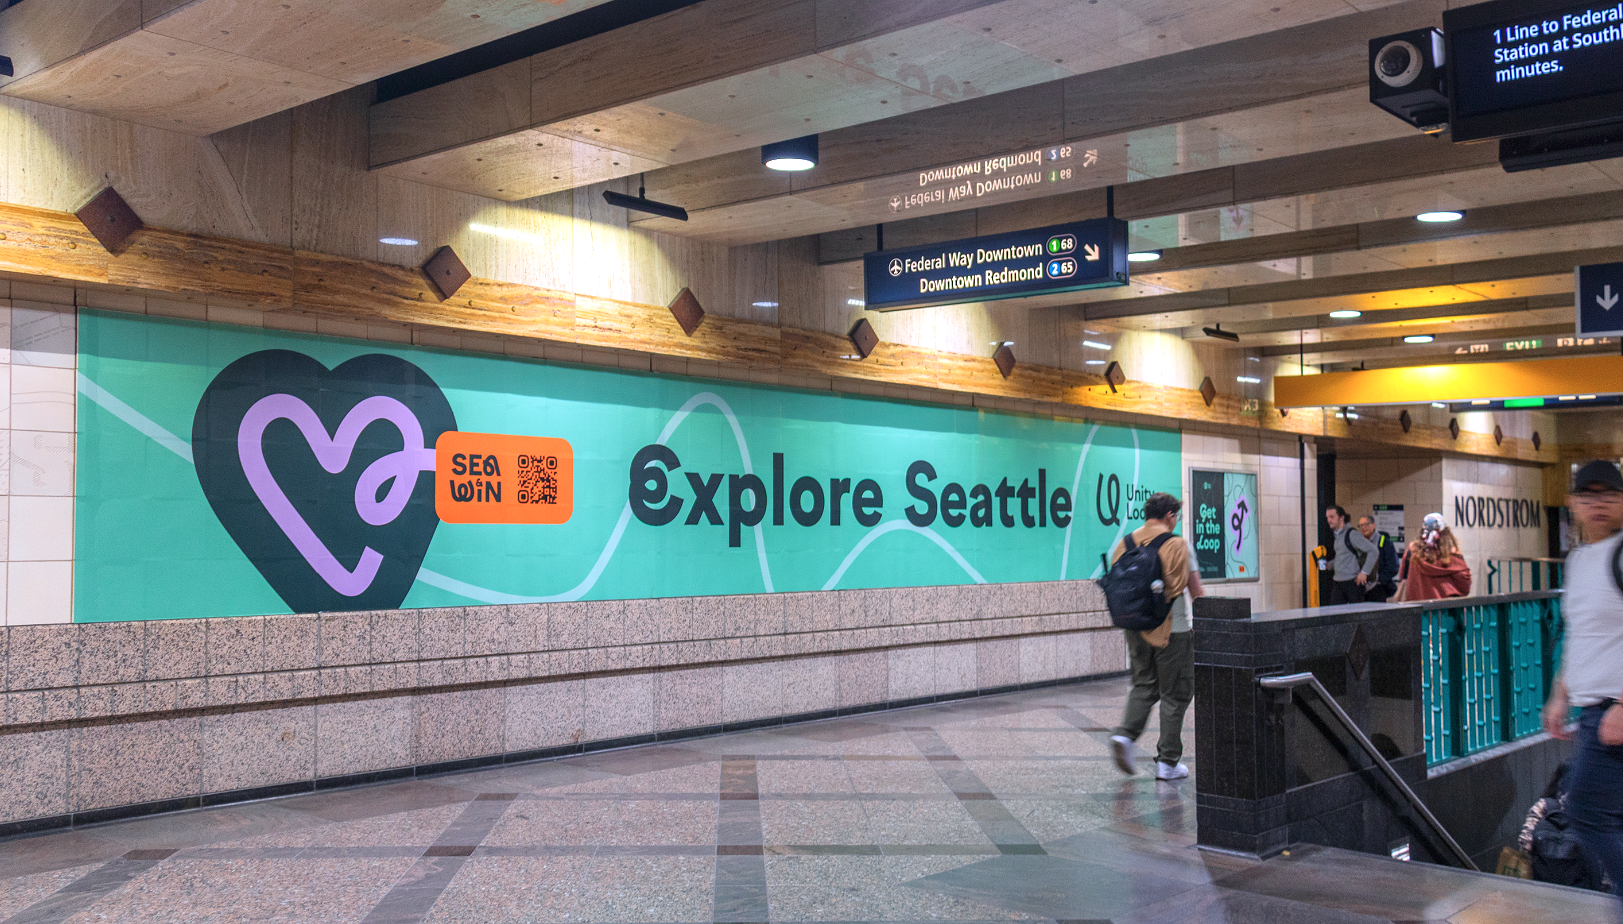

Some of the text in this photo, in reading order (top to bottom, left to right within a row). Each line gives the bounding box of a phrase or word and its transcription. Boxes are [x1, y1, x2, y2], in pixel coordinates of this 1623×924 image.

[1493, 2, 1623, 44] 1 Line to Federal
[1494, 22, 1623, 64] Station at South
[1495, 59, 1564, 83] minutes.
[905, 238, 1073, 273] Federal Way Downtown 1 68
[919, 261, 1073, 293] Downtown Redmond 2 65
[451, 453, 501, 476] SEA
[628, 443, 1072, 548] Explore Seattle
[1454, 495, 1541, 528] NORDSTROM
[1195, 518, 1220, 534] in the
[1199, 503, 1216, 523] Get
[1196, 534, 1220, 554] Loop
